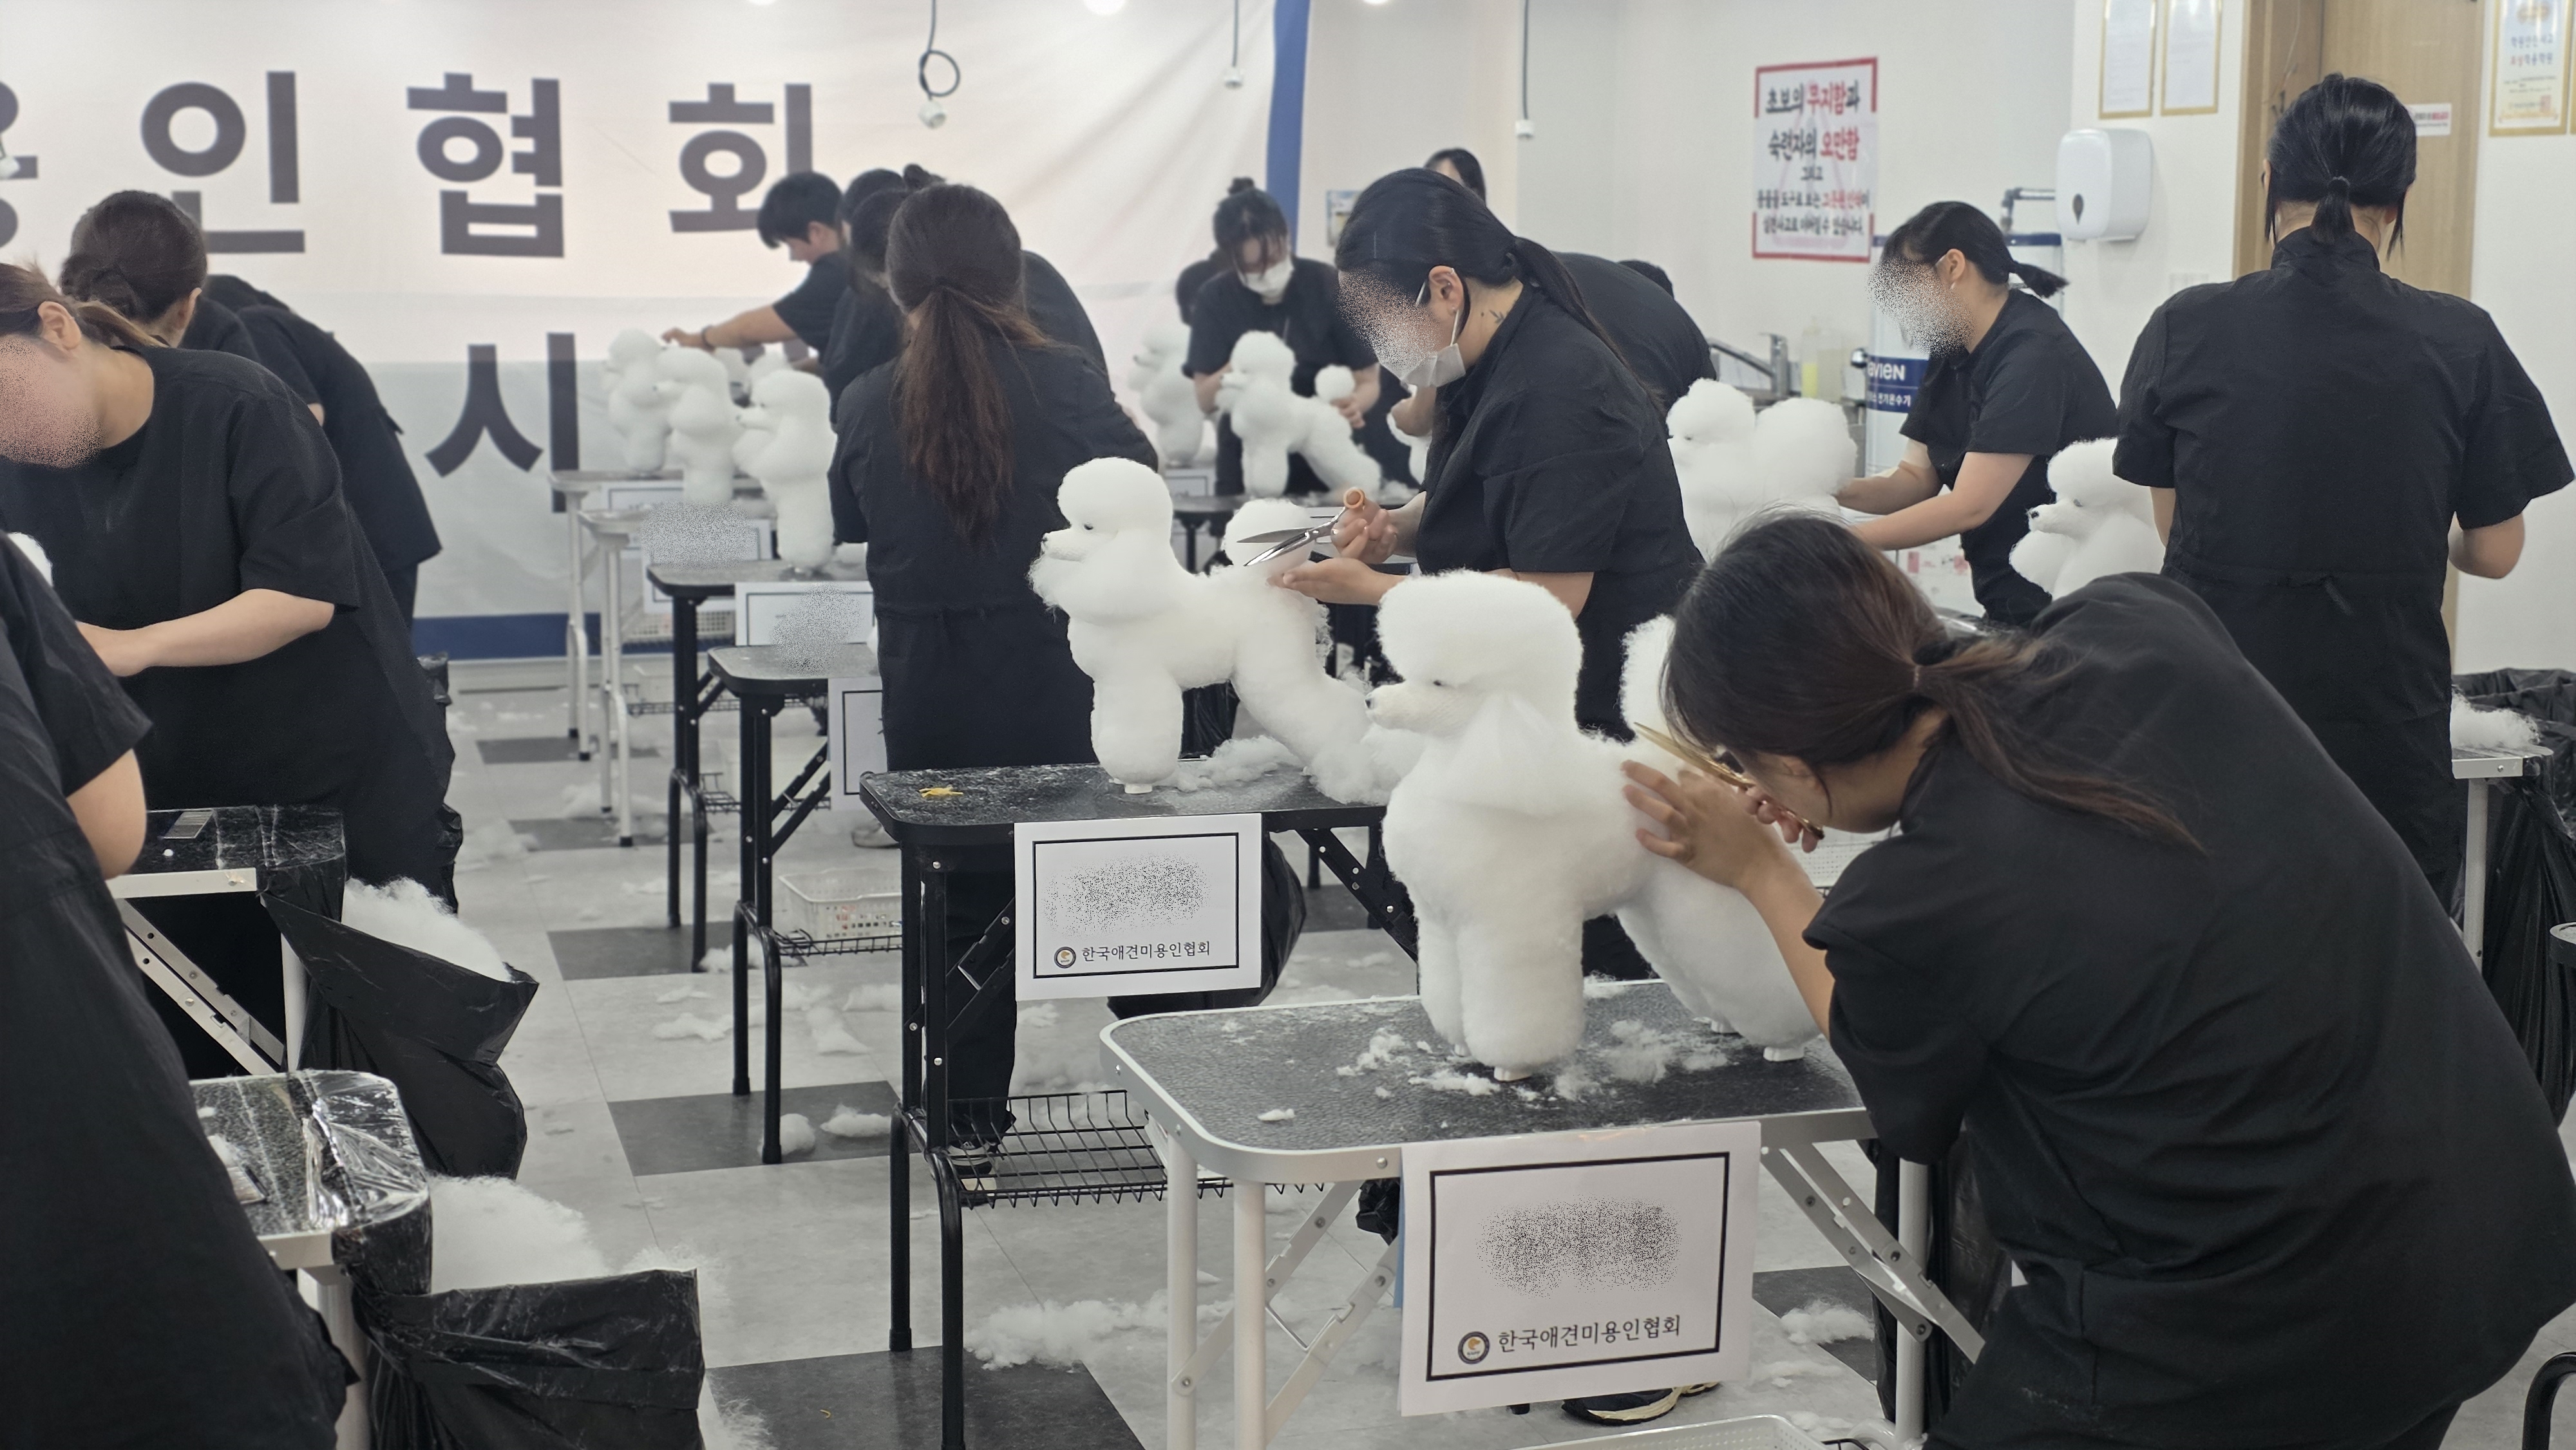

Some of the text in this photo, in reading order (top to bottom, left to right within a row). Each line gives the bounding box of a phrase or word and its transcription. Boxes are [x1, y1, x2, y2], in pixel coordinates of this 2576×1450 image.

[1766, 79, 1861, 115] 초보의 무지함과
[1768, 126, 1860, 161] 숙련자의 오만함
[1082, 941, 1210, 962] 한국애견미용인협회
[1498, 1315, 1680, 1353] 한국애견미용인협회
